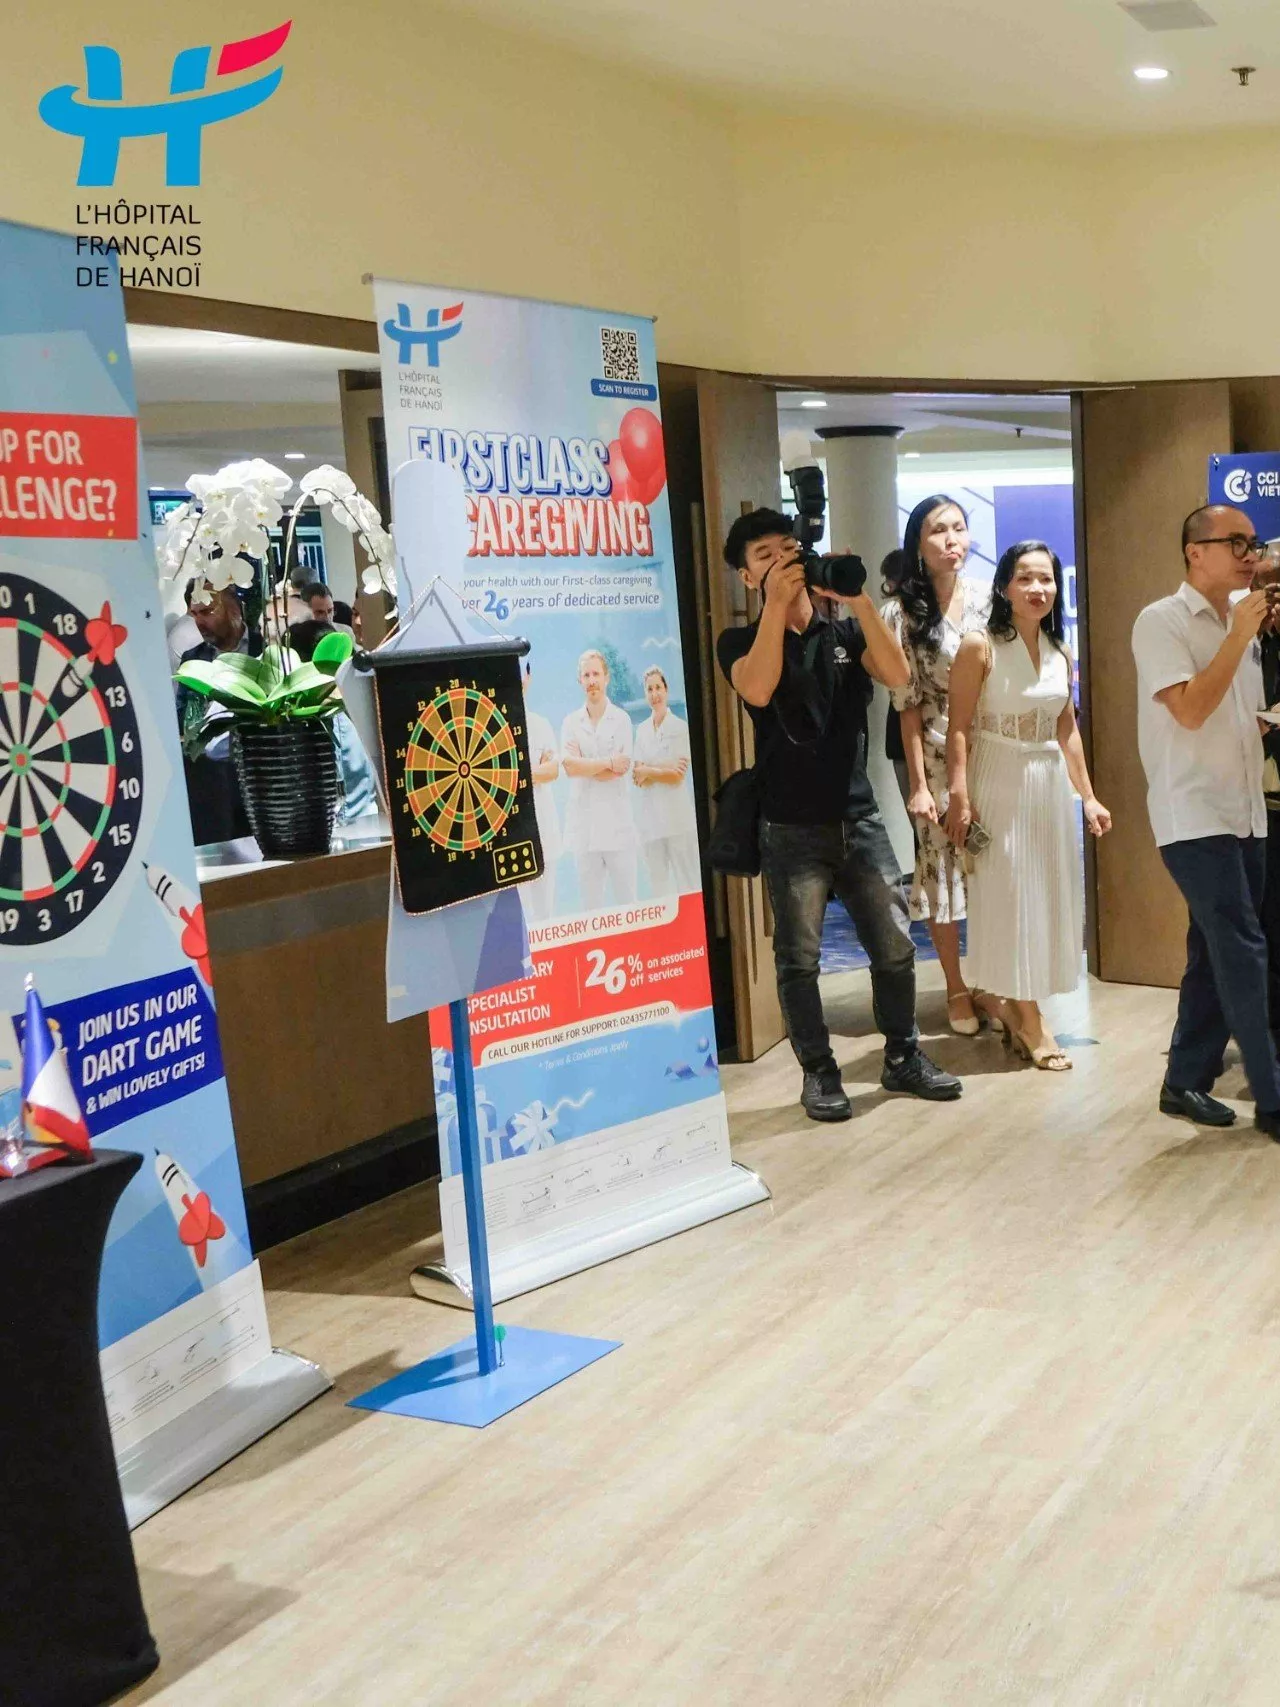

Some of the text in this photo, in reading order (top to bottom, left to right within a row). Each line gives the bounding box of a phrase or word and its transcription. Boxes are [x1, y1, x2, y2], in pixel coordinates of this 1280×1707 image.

[400, 385, 442, 398] FRANÇAIS
[599, 384, 613, 393] SCAN
[400, 398, 412, 408] DE
[0, 428, 84, 465] P FOR
[1257, 472, 1278, 485] CCI
[0, 475, 116, 521] LENGE?
[521, 576, 541, 586] with
[544, 578, 559, 586] our
[613, 575, 653, 587] caregiving
[24, 592, 36, 614] 1
[462, 590, 660, 620] ver 26 years of dedicated service
[52, 613, 78, 635] 18
[105, 686, 127, 707] 13
[121, 732, 133, 753] 6
[119, 778, 140, 799] 10
[109, 824, 132, 847] 15
[91, 861, 105, 882] 2
[65, 889, 84, 913] 17
[37, 909, 52, 932] 3
[592, 913, 621, 930] CARE
[647, 959, 659, 969] on
[660, 945, 705, 966] associated
[585, 949, 627, 994] 26
[630, 967, 684, 987] off services
[77, 983, 197, 1051] JOIN US IN OUR
[488, 1006, 670, 1060] CALL OUR HOTLINE FOR SUPPORT: 02435771100
[82, 1015, 202, 1087] DART GAME
[86, 1052, 205, 1114] & WIN LOVELY GIFTS!
